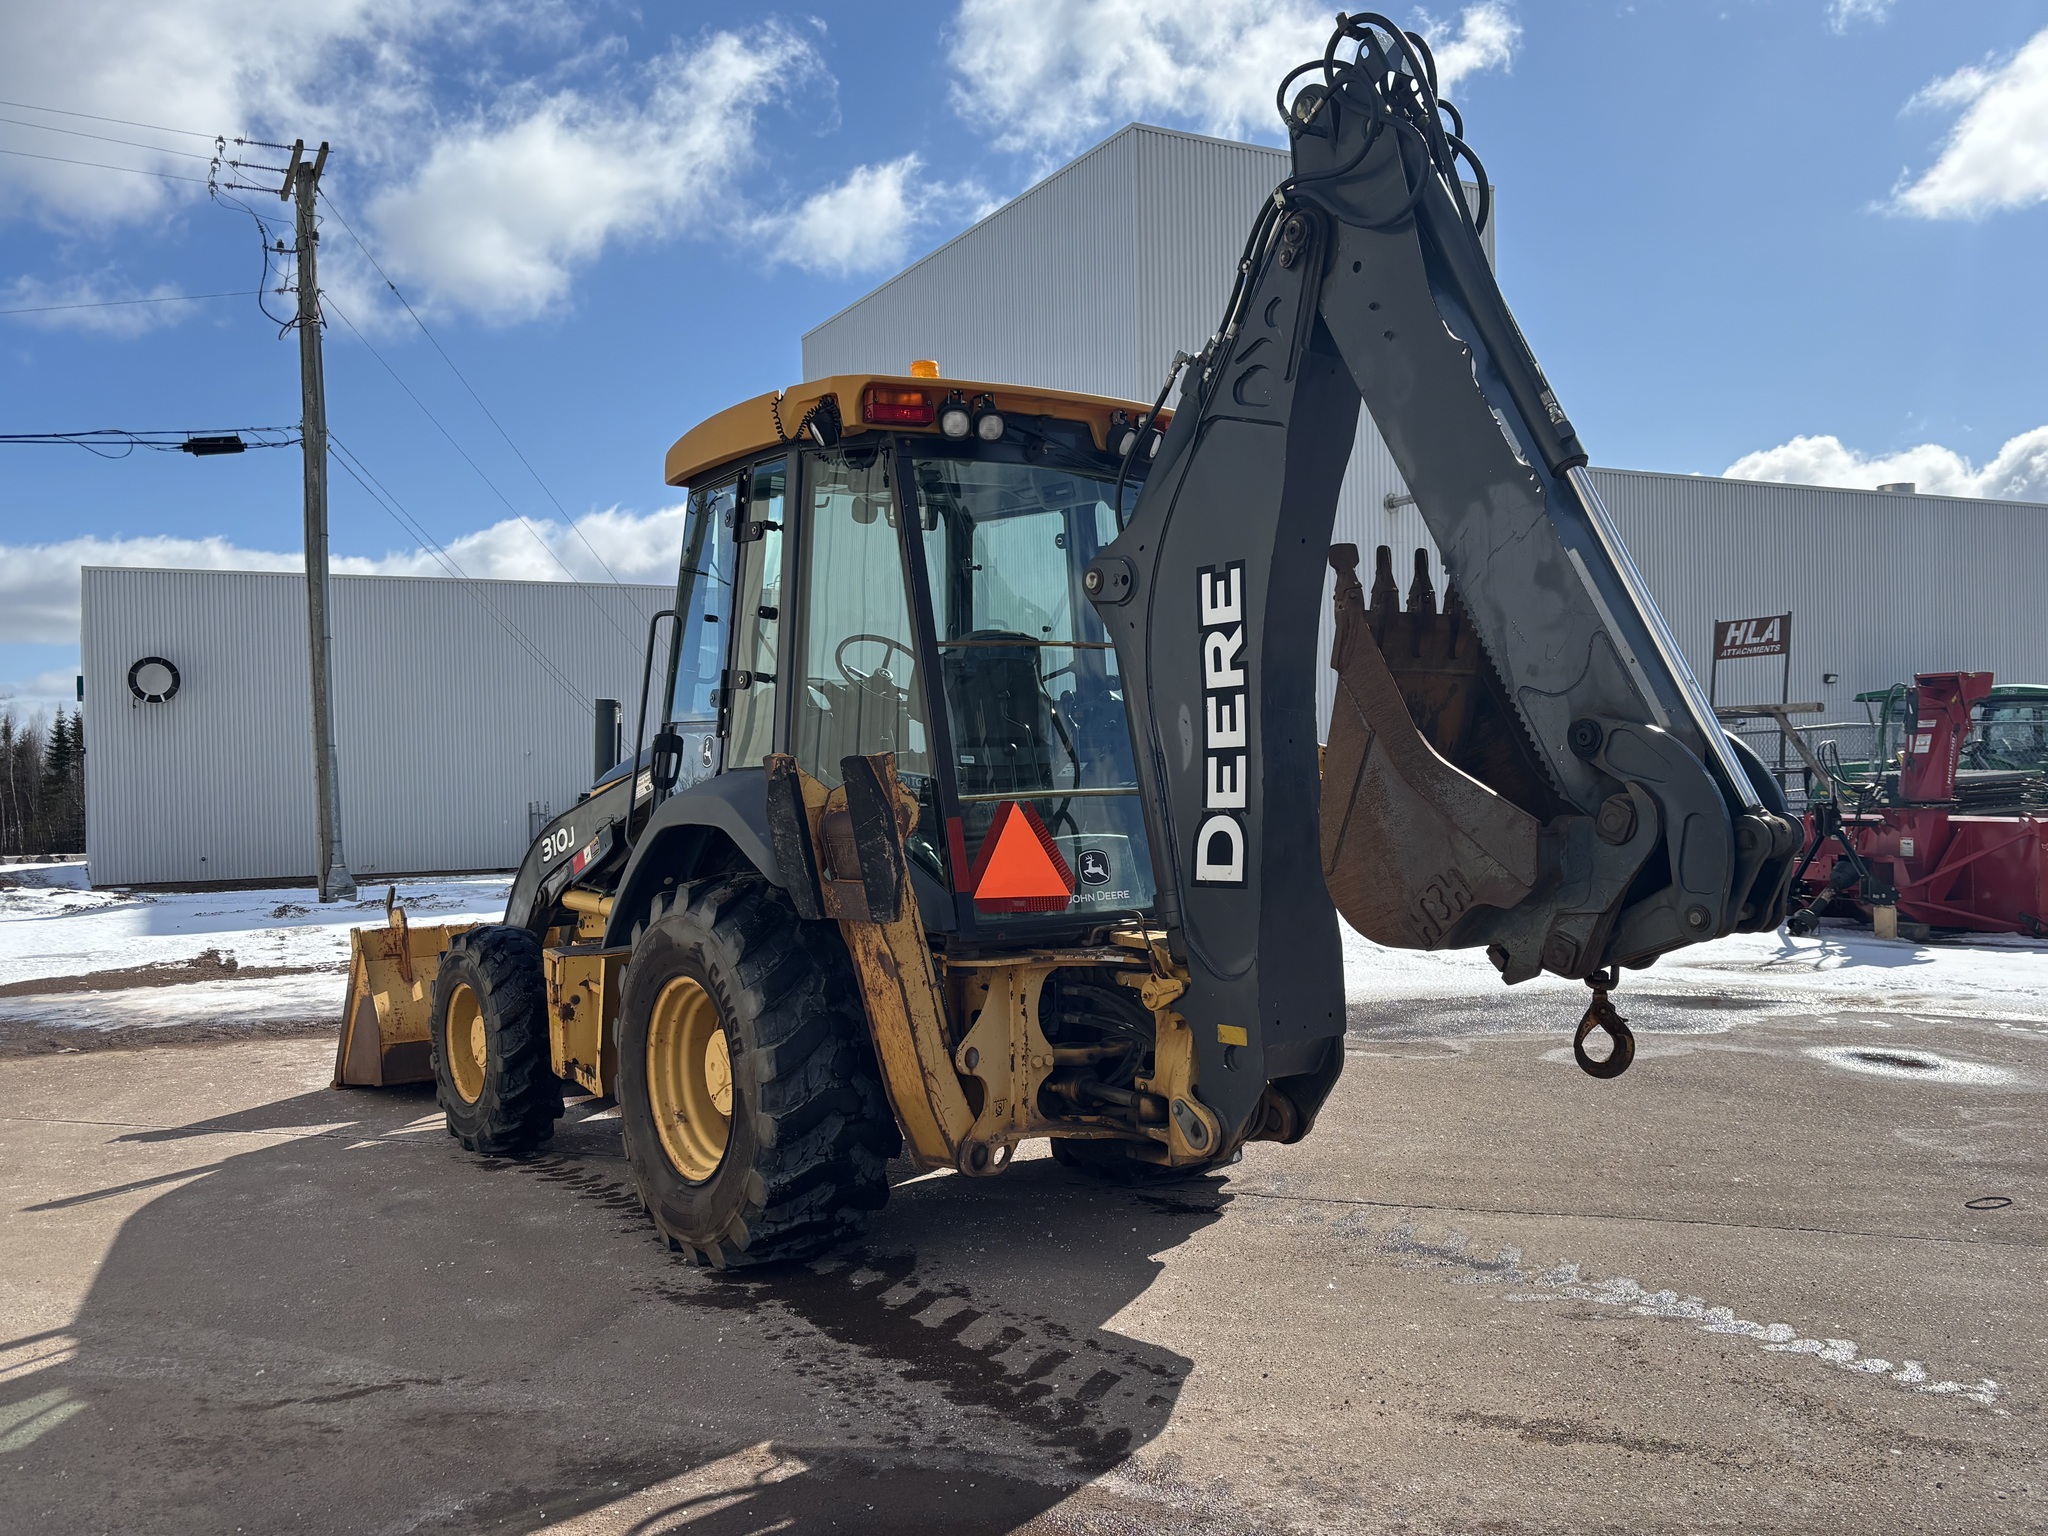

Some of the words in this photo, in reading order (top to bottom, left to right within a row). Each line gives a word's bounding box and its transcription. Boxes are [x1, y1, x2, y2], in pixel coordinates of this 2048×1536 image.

[1723, 618, 1780, 646] HLA
[1721, 645, 1781, 657] ATTACHMENTS
[1196, 568, 1246, 882] DEERE
[541, 826, 575, 863] 310J
[1068, 892, 1096, 904] JOHN
[1097, 890, 1130, 901] DEERE
[708, 962, 744, 1057] CAMSO
